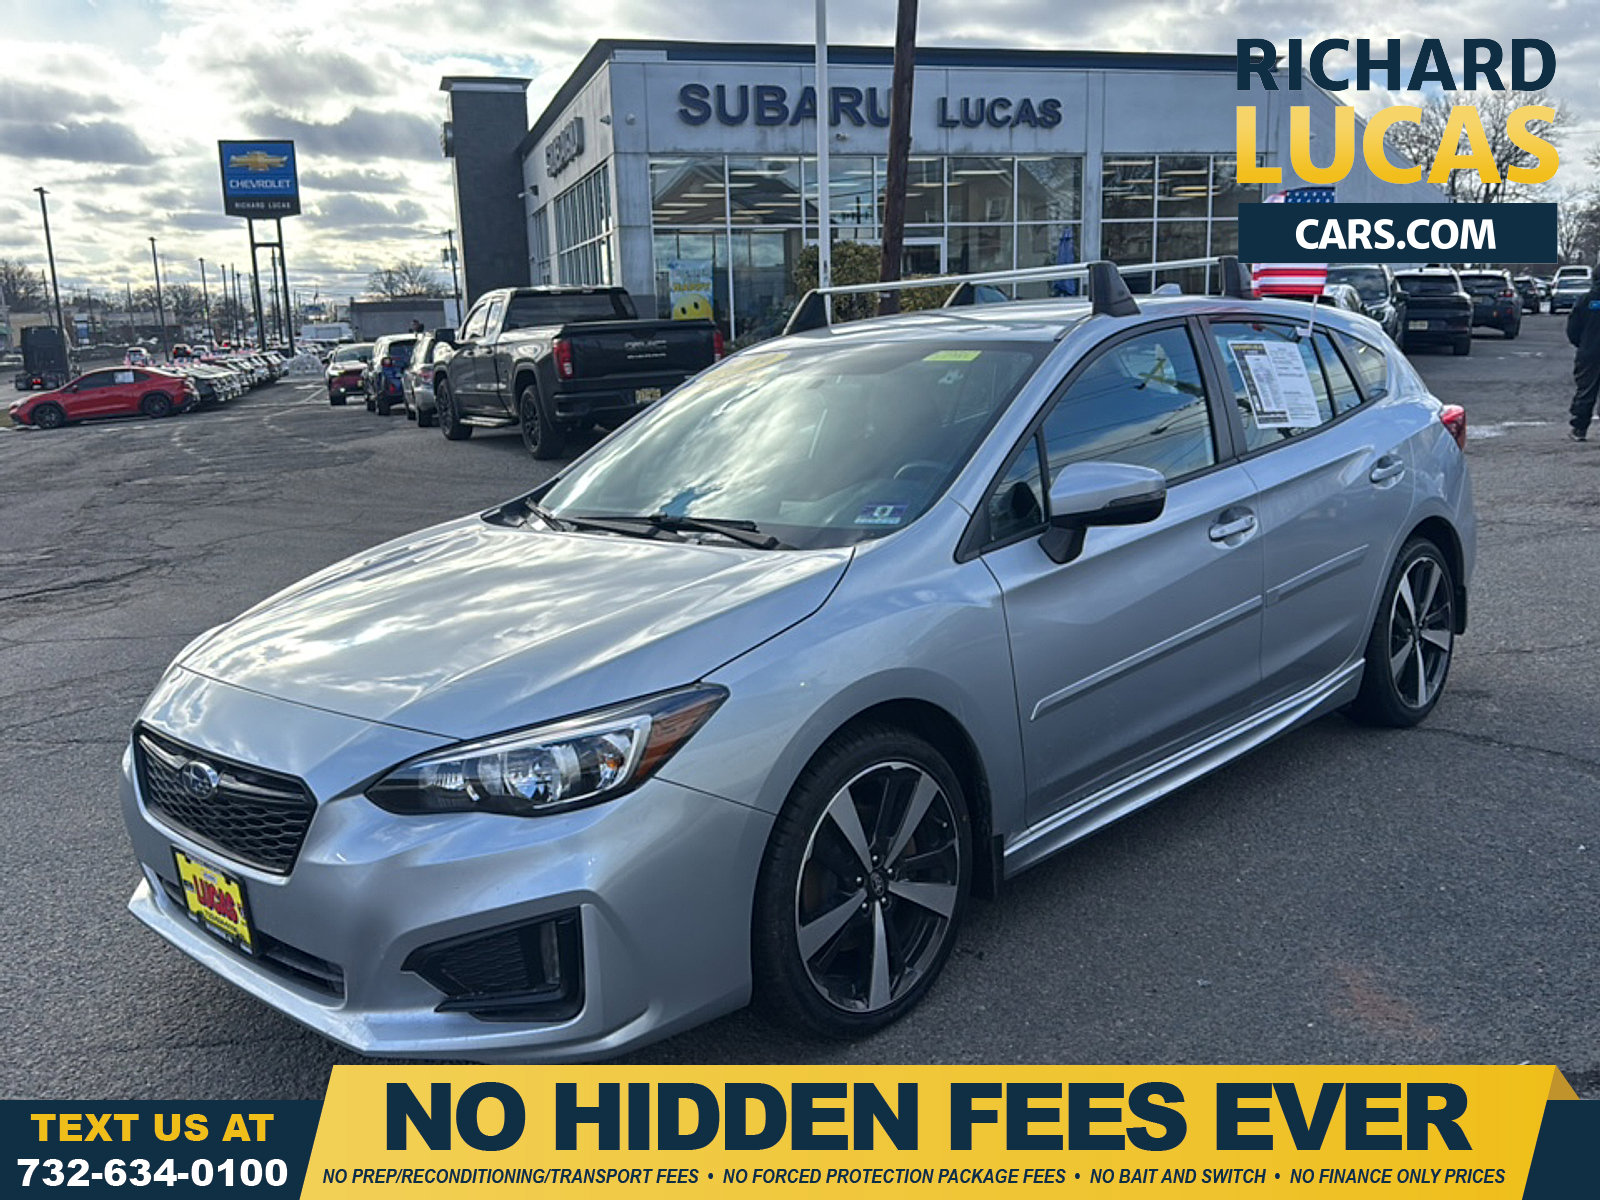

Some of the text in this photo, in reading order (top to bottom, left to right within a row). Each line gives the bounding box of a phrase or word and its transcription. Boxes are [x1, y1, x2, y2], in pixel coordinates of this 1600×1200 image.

[678, 82, 1063, 129] SUBARU LUCAS
[229, 179, 291, 190] CHEVROLET
[234, 201, 292, 209] RICHARD LUCAS
